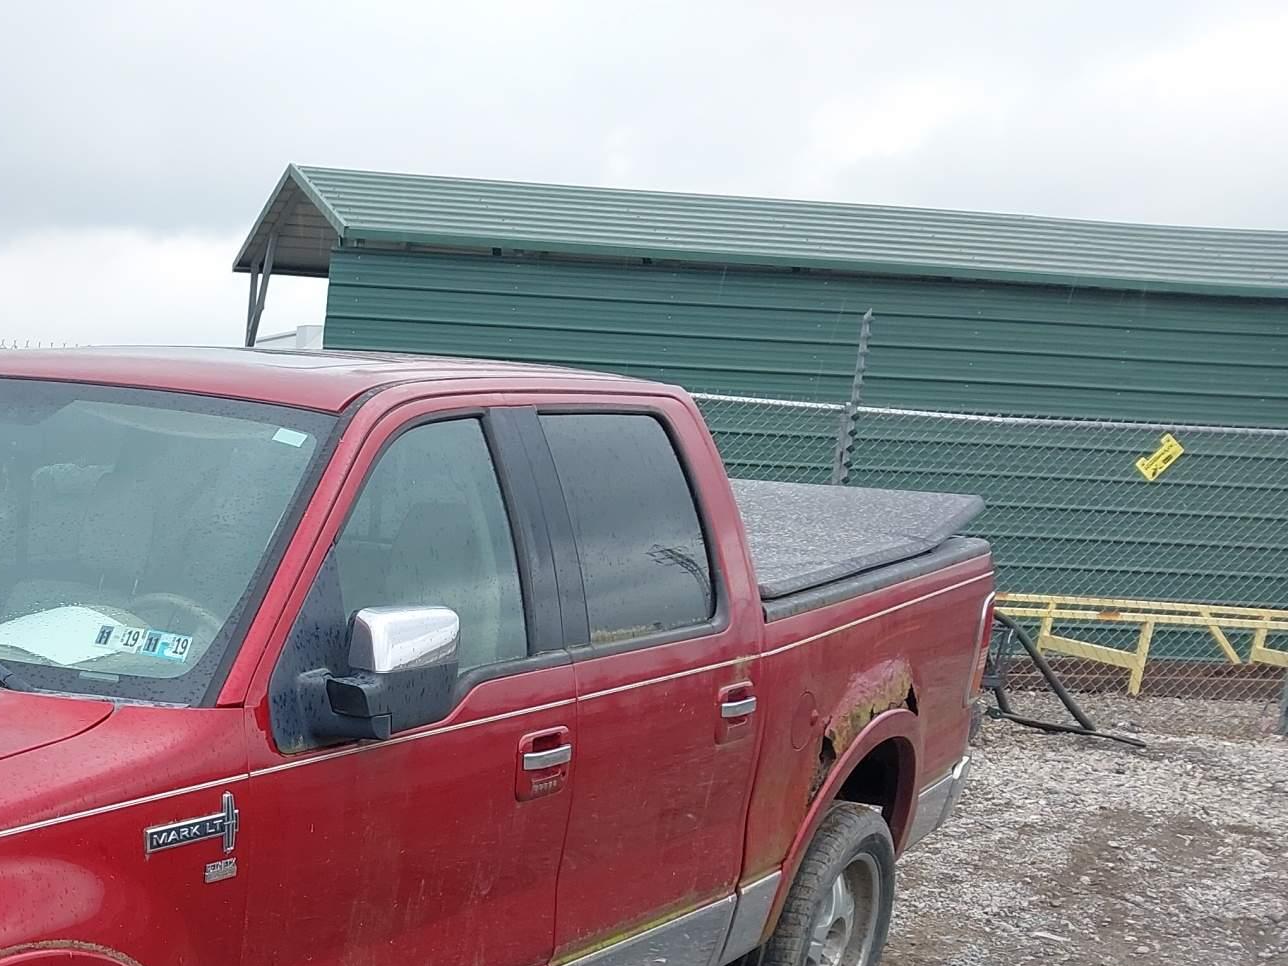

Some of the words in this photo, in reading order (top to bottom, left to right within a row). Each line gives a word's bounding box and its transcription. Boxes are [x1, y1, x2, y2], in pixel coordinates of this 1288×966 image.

[98, 628, 113, 646] 11
[123, 630, 140, 647] 19
[145, 636, 160, 652] 11
[172, 637, 189, 655] 19
[153, 824, 201, 846] MARK
[206, 820, 223, 833] LT
